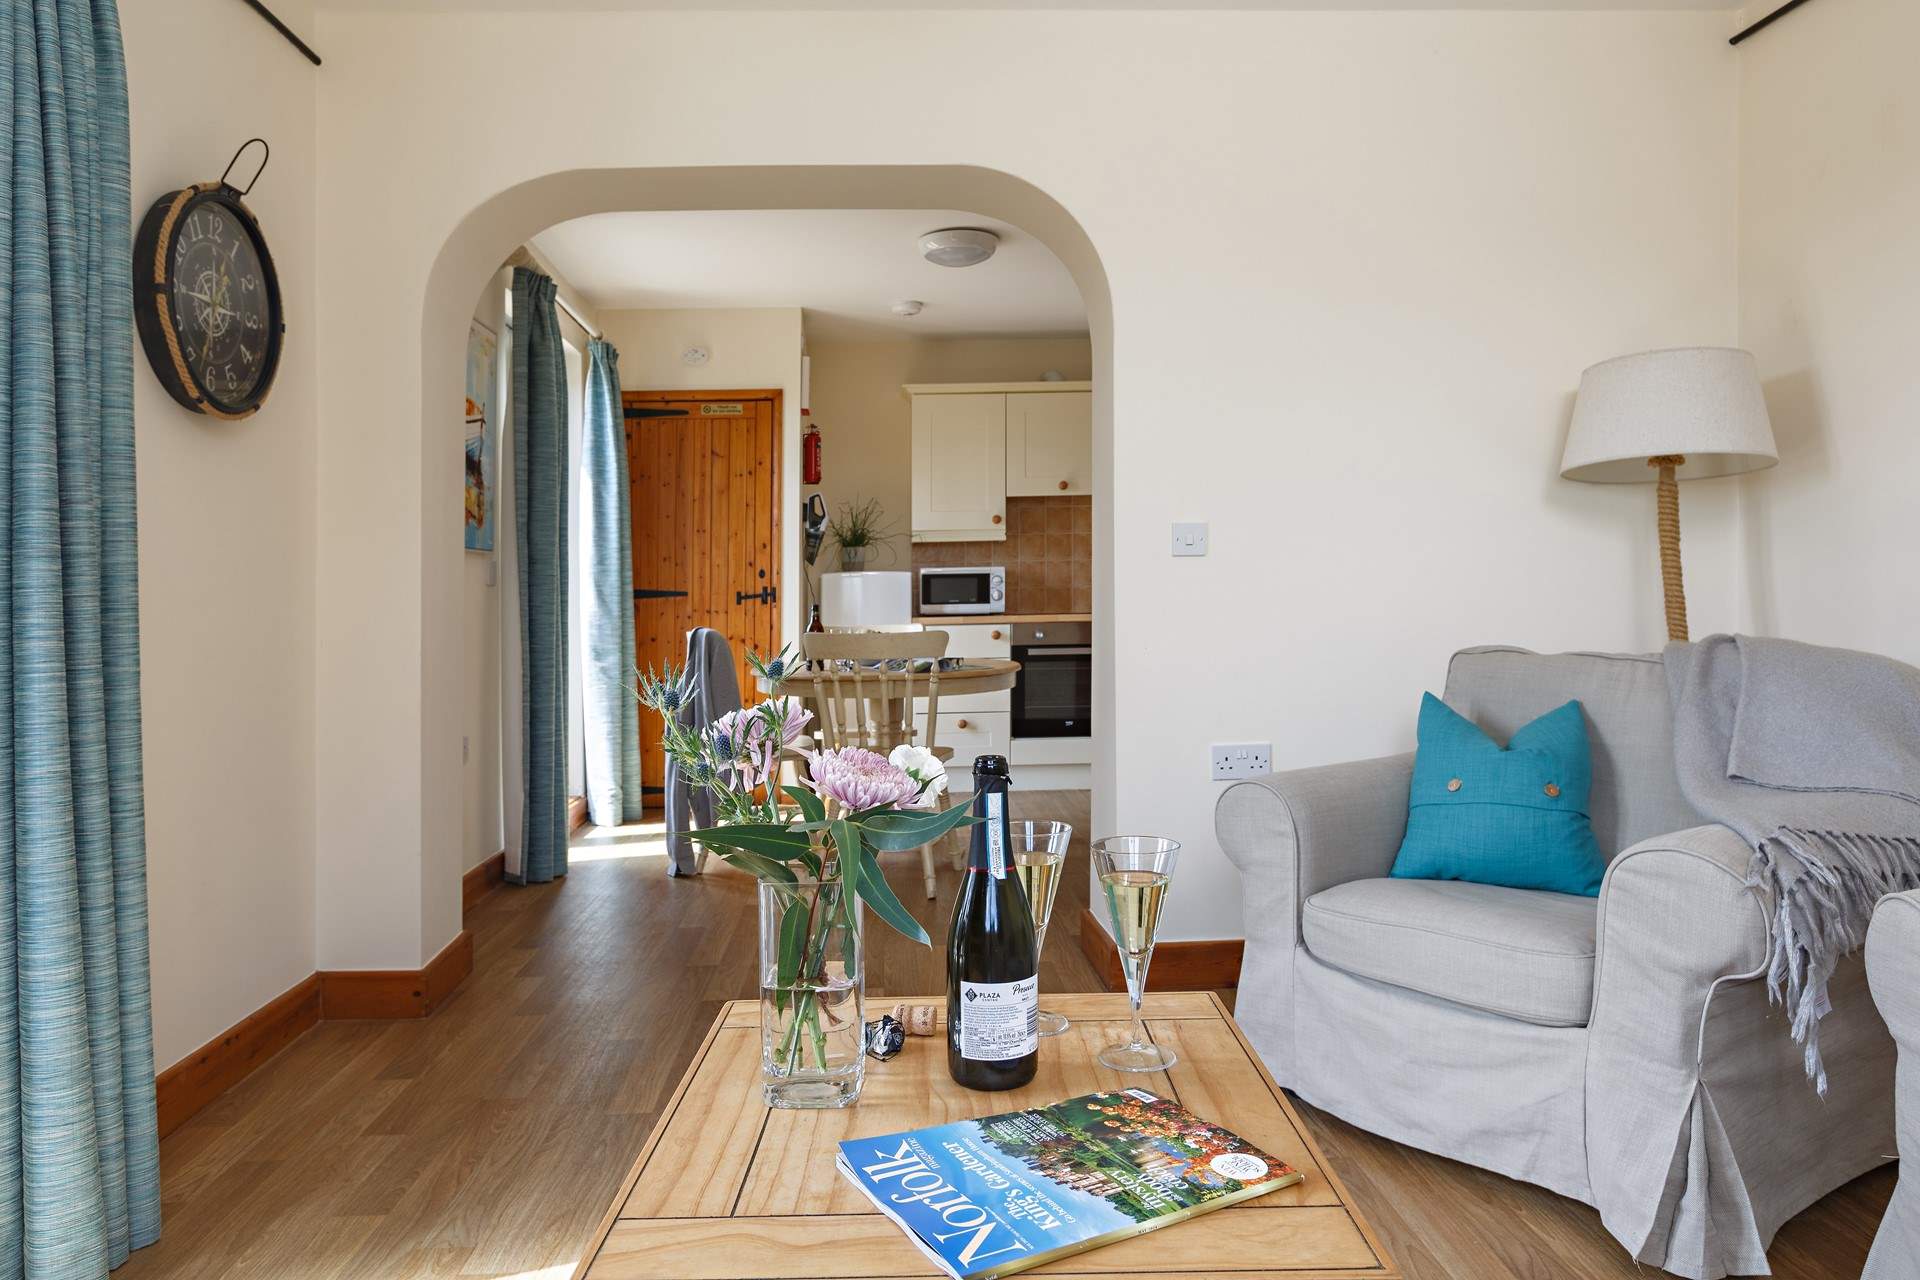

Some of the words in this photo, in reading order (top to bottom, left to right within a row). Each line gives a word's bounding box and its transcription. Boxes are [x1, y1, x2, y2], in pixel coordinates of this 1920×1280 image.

[188, 213, 203, 243] 11
[207, 213, 224, 243] 12
[228, 239, 240, 261] 1
[240, 274, 255, 293] 2
[245, 312, 259, 329] 3
[239, 343, 253, 365] 4
[206, 365, 217, 391] 6
[225, 364, 237, 391] 5
[907, 1137, 942, 1169] magazine
[943, 1141, 1009, 1190] Gardener
[862, 1139, 1028, 1268] Norfolk
[1004, 1195, 1026, 1220] The
[1005, 1188, 1062, 1231] King's
